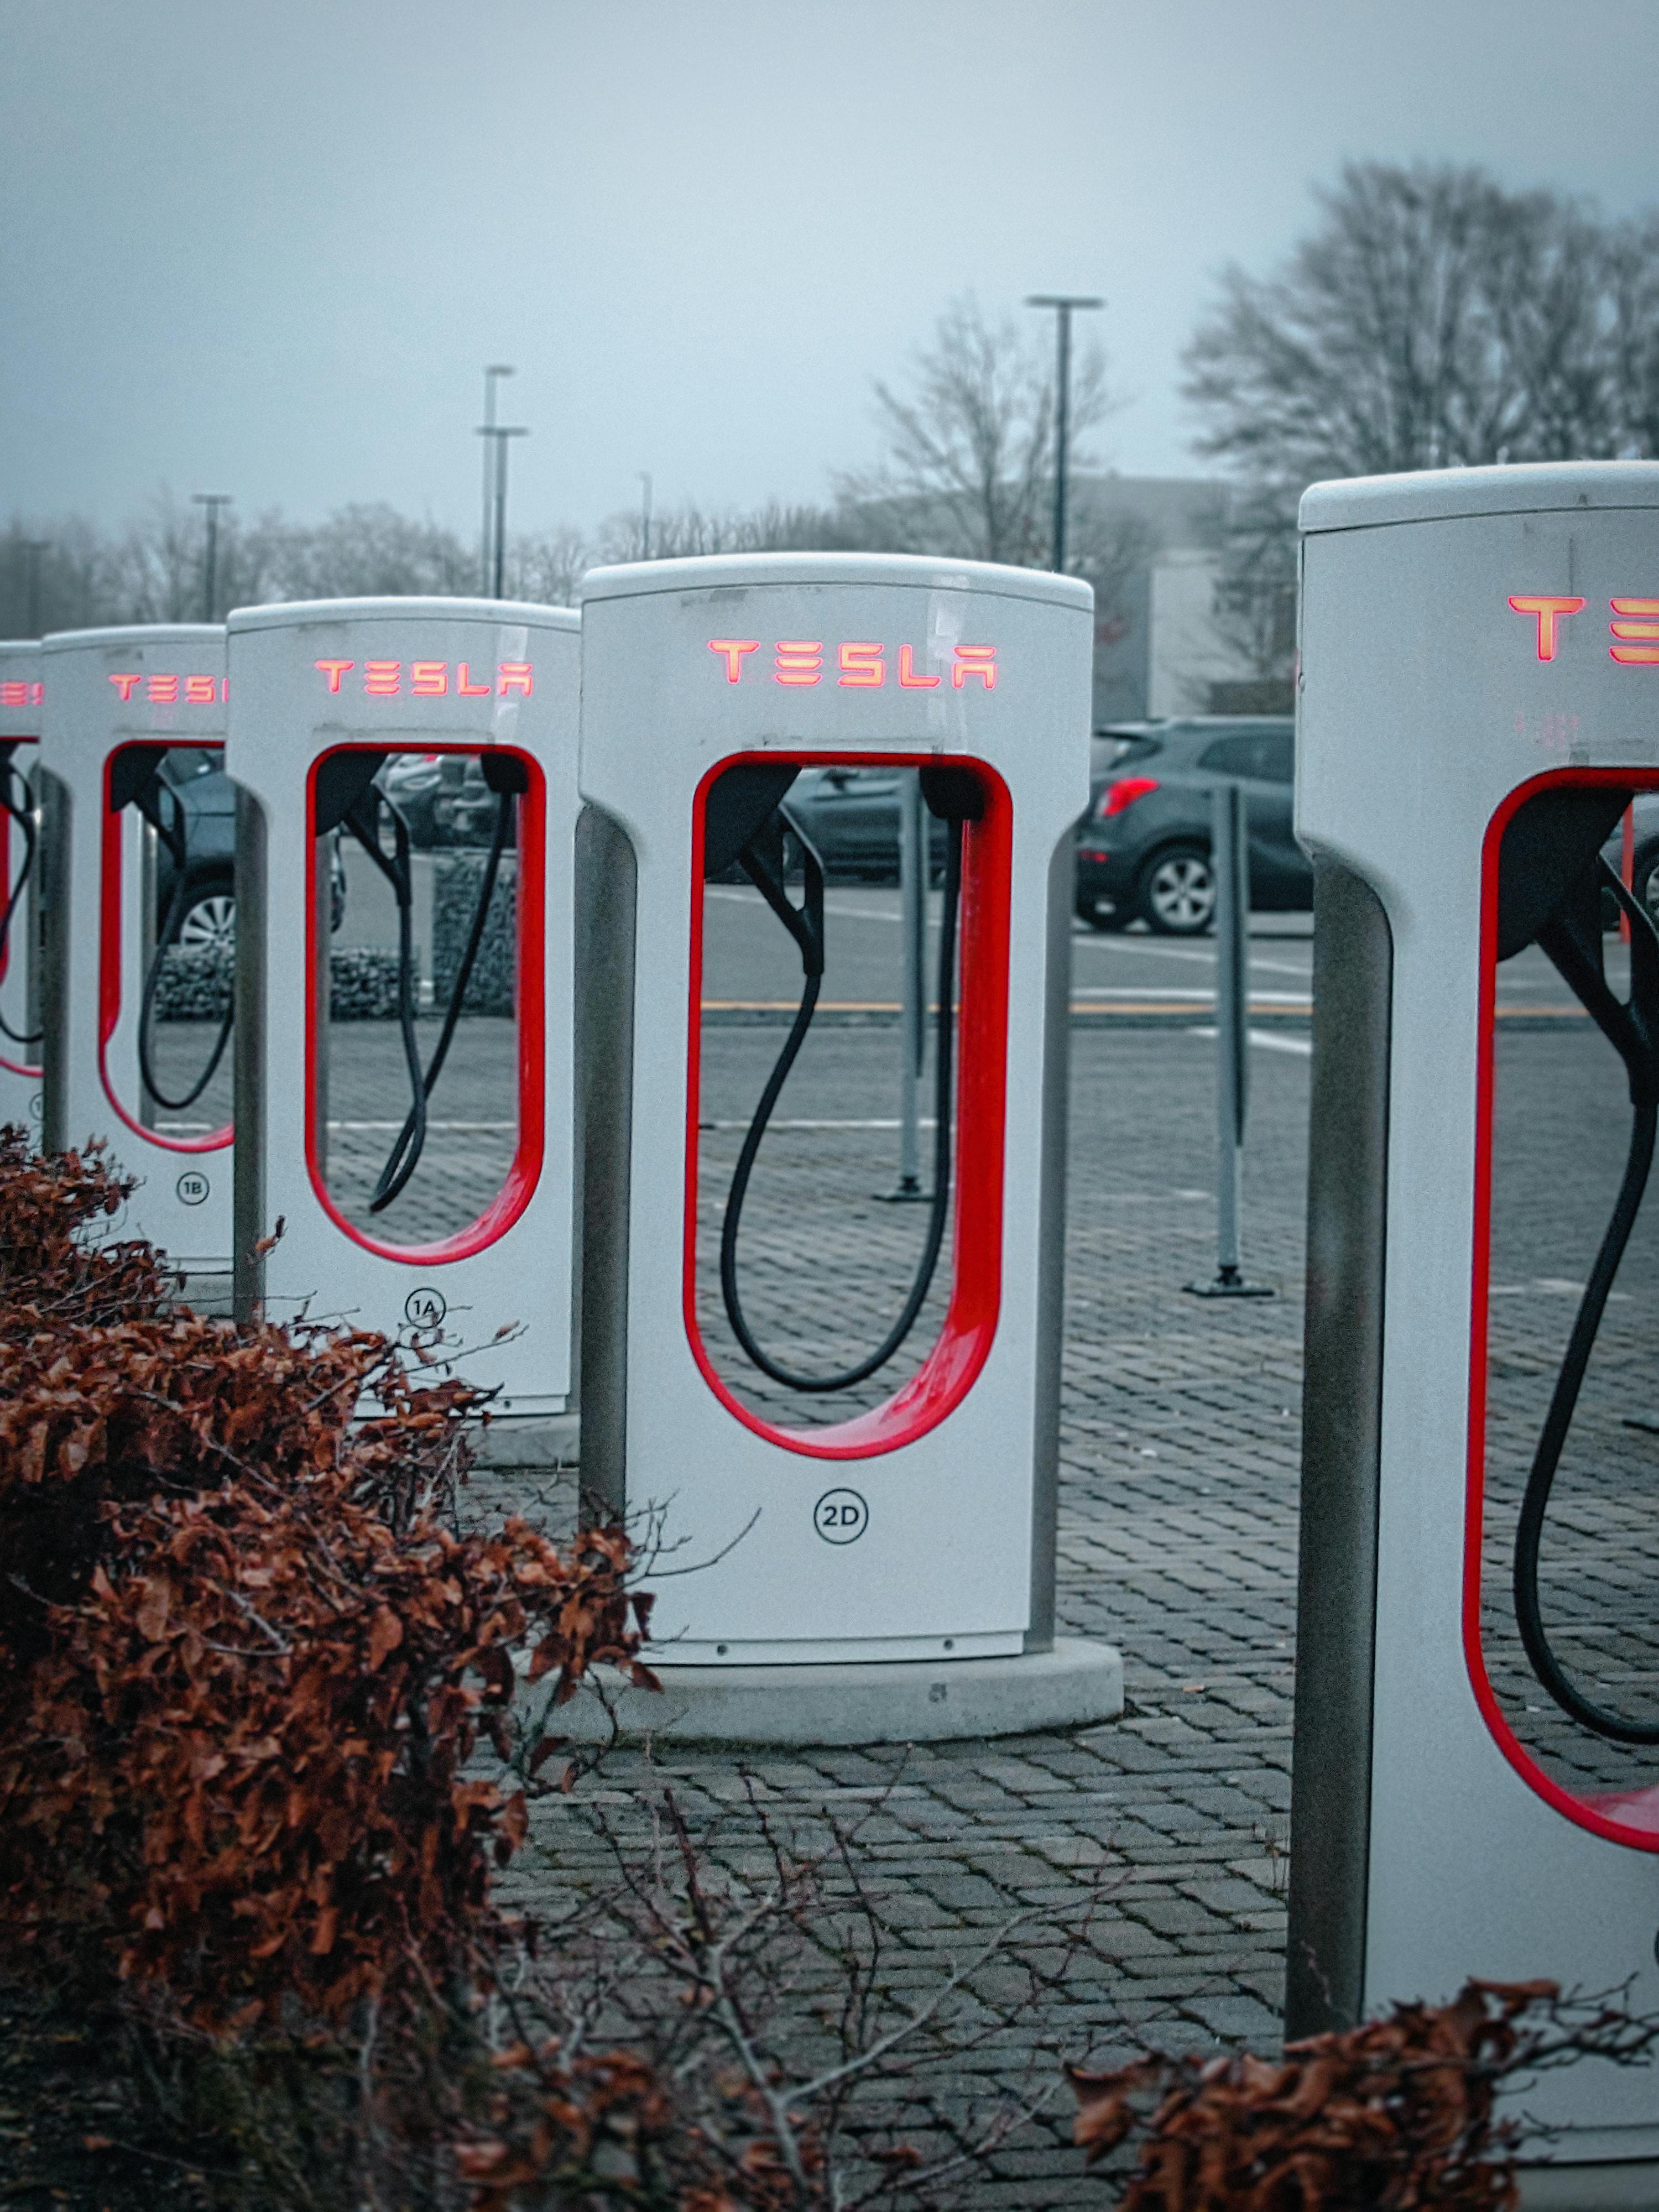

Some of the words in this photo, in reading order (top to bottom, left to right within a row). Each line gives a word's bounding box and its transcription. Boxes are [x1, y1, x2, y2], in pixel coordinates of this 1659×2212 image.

[708, 640, 996, 689] TESLA
[108, 674, 229, 703] TES
[315, 660, 533, 696] TESLA
[184, 1182, 202, 1194] 1B
[414, 1300, 435, 1314] 1A
[823, 1506, 859, 1526] 2D
